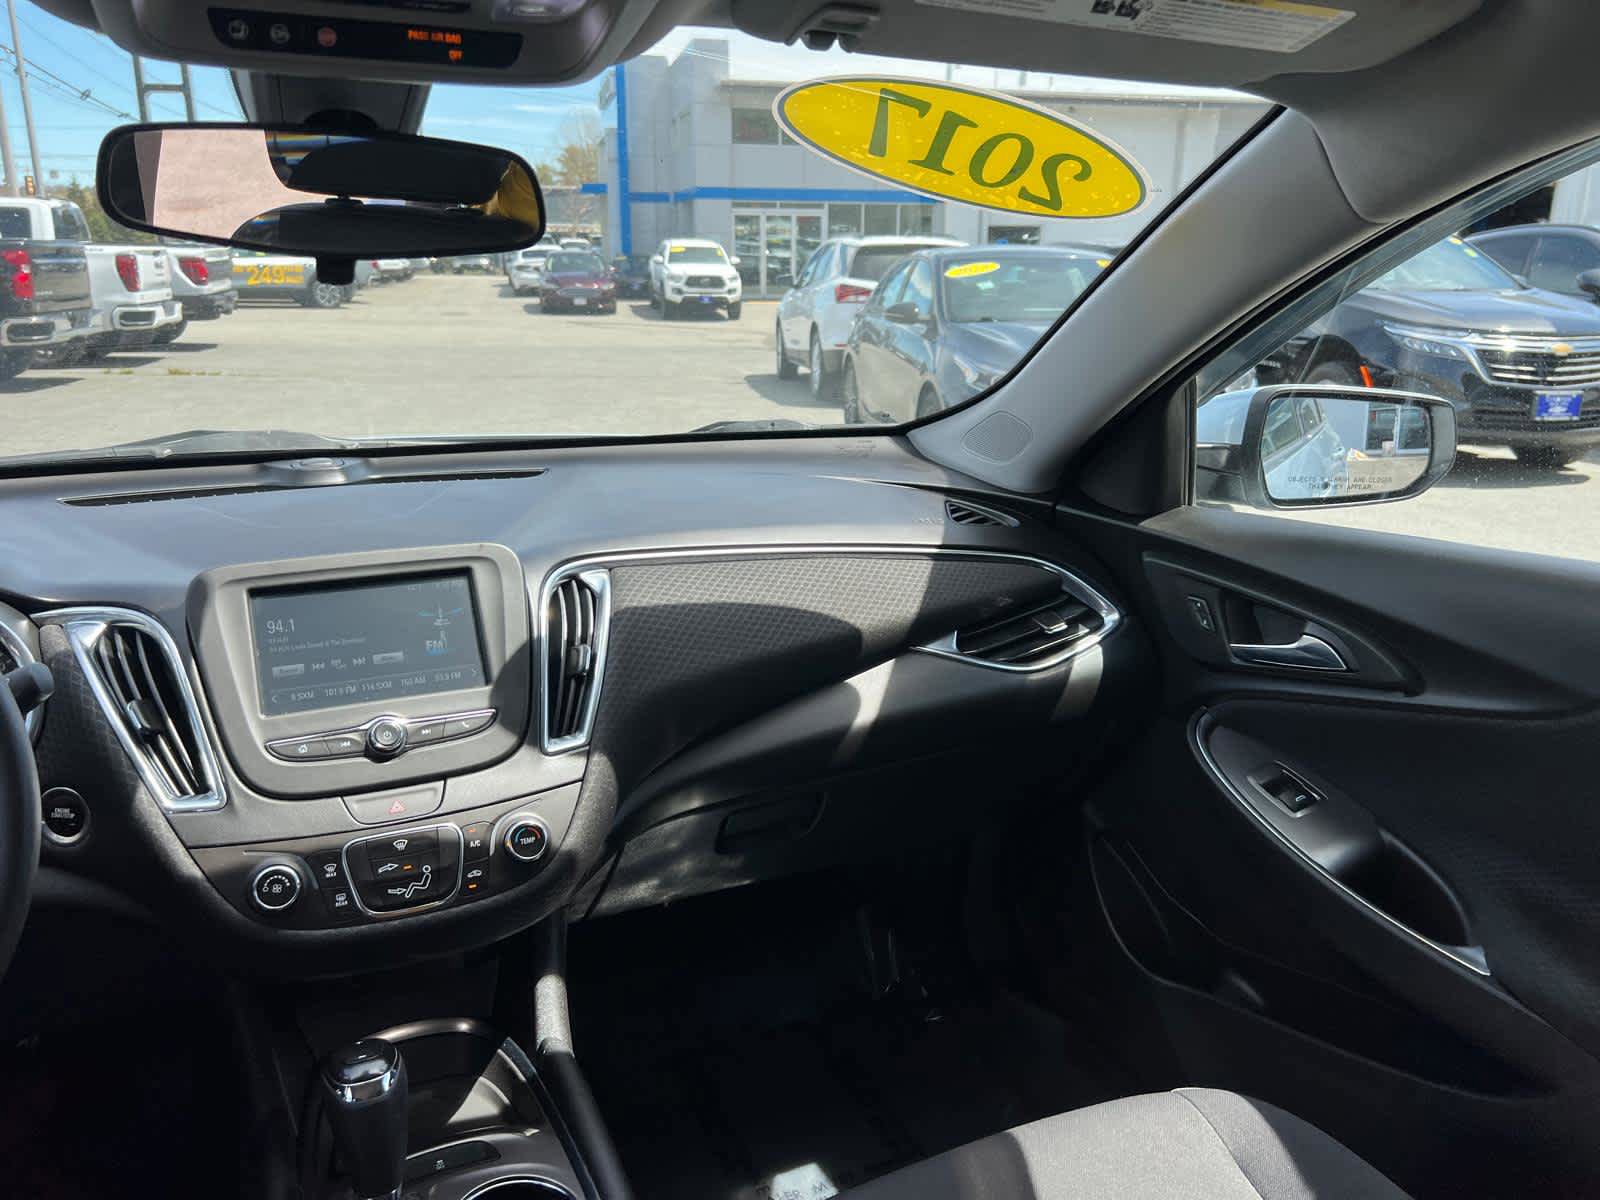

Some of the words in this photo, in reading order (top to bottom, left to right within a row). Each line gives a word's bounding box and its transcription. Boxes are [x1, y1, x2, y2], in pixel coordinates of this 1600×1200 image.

[448, 49, 462, 60] OFF
[266, 618, 296, 634] 94.1
[469, 839, 481, 848] A/C
[519, 835, 537, 846] TEMP
